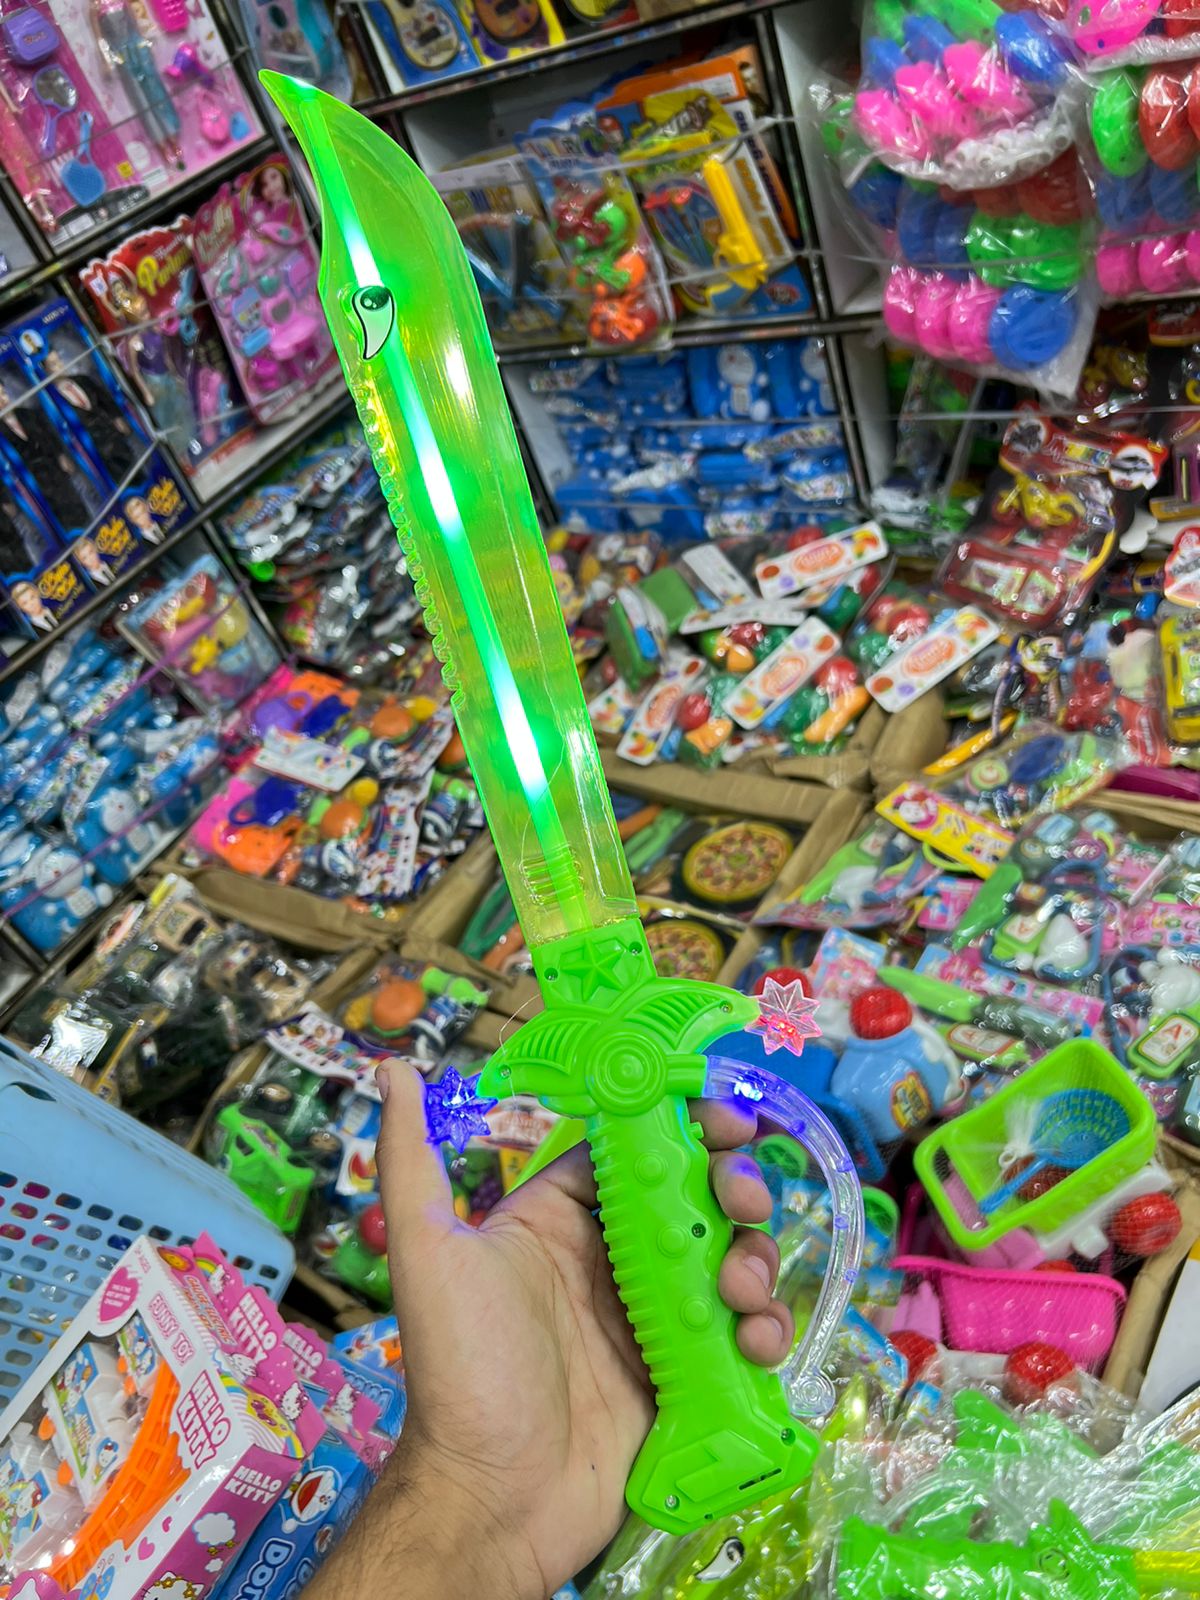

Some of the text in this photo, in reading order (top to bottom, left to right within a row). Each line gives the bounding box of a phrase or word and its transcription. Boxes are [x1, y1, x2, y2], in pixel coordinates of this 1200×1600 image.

[150, 1292, 195, 1364] FUNNY TOY
[229, 1306, 268, 1363] KITTY
[239, 1292, 277, 1351] HELLO
[282, 1328, 323, 1368] HELLO
[177, 1390, 216, 1469] KITTY
[190, 1369, 231, 1447] HELLO
[224, 1478, 276, 1504] KITTY
[234, 1465, 282, 1493] HELLO
